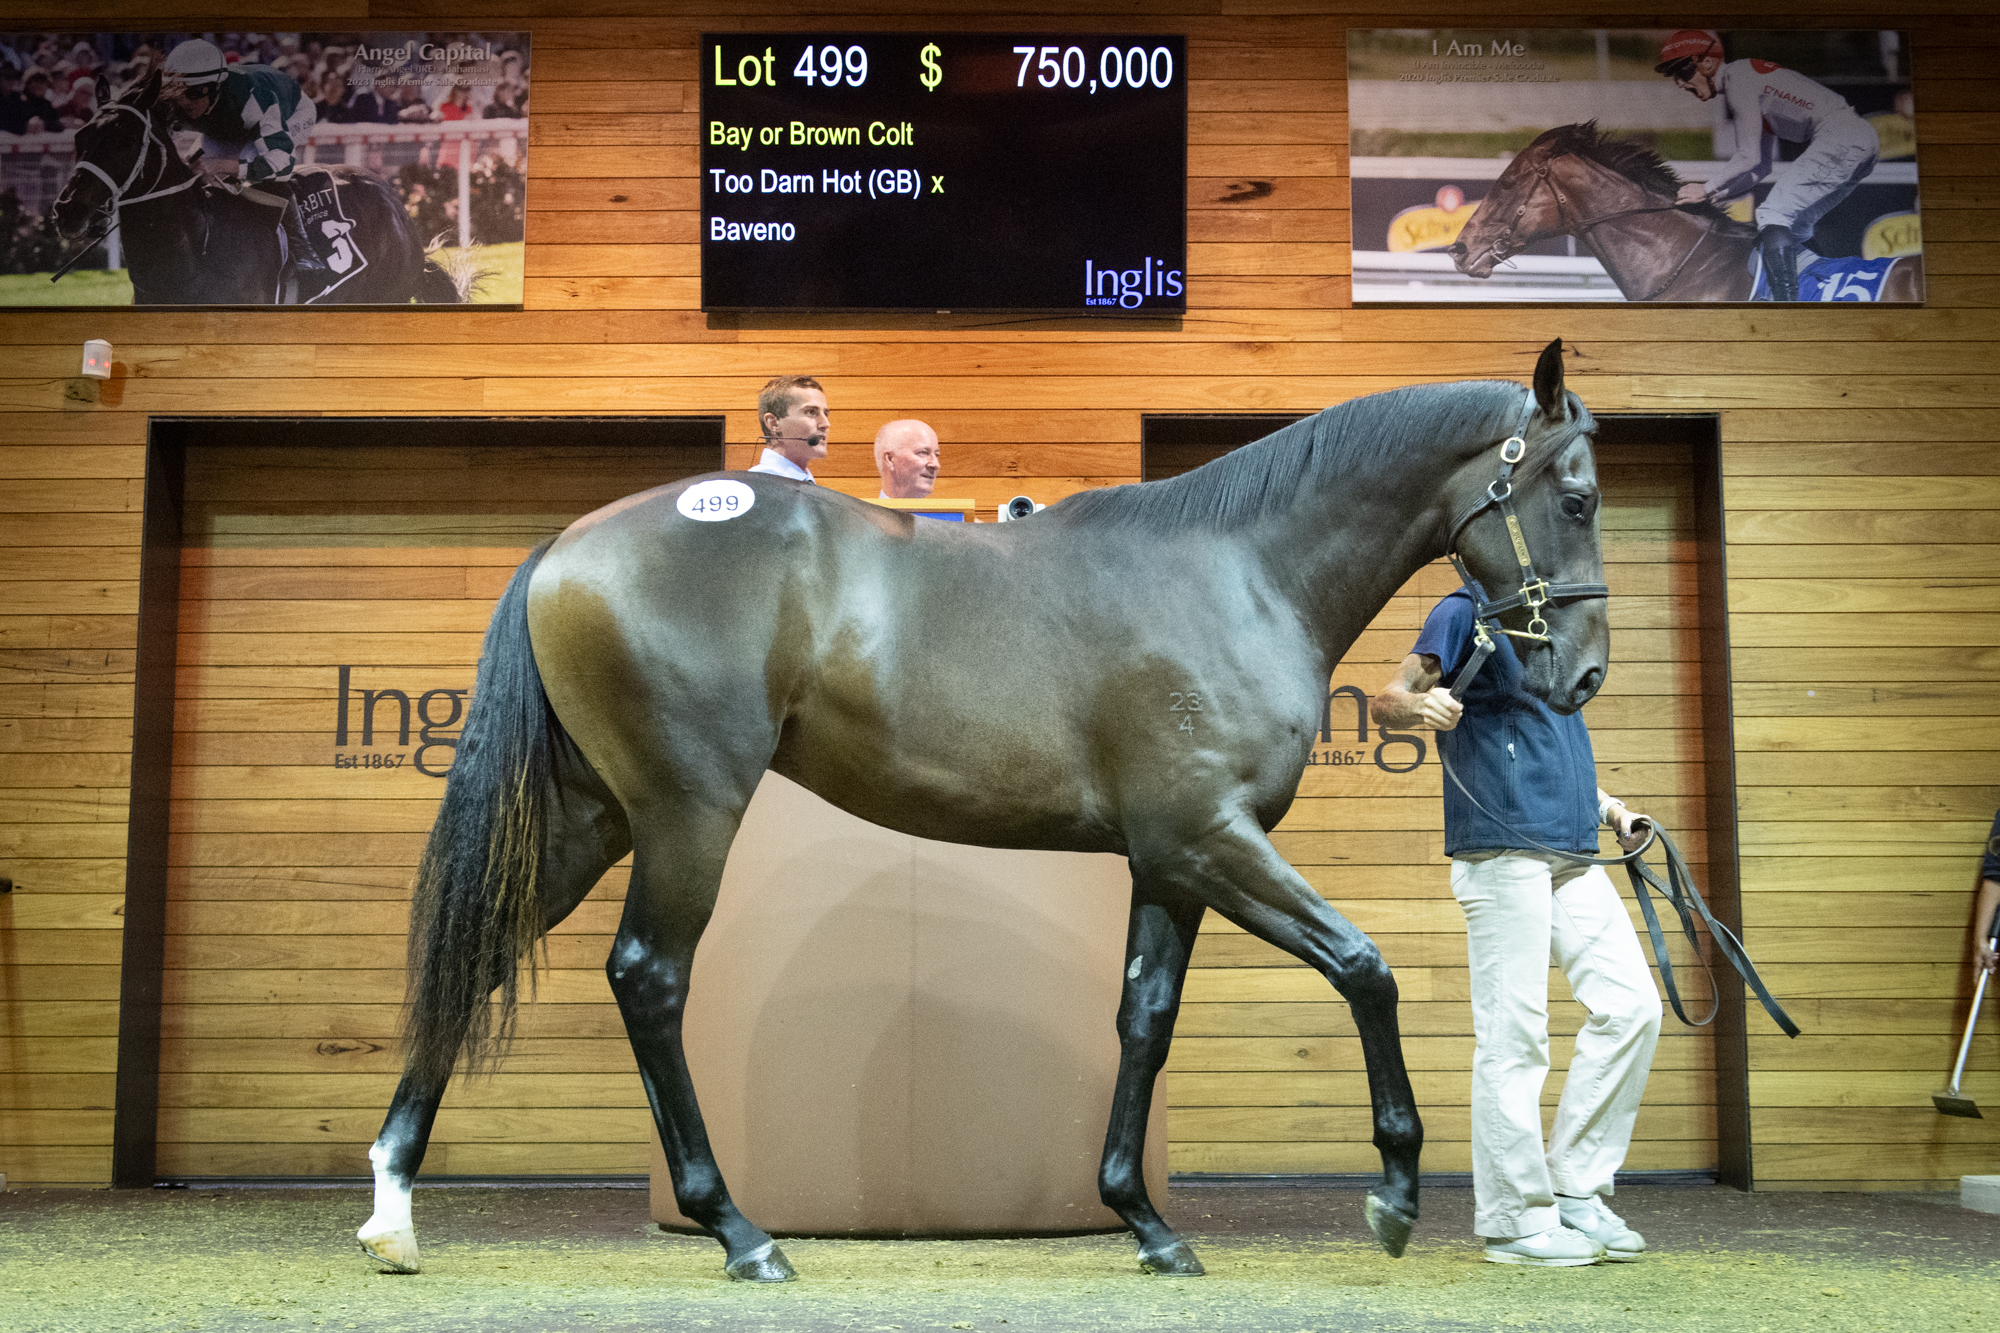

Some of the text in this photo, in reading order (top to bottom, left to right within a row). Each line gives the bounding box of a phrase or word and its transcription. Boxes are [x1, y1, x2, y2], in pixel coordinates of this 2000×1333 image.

[354, 42, 491, 66] Angel Capital
[1432, 39, 1525, 57] I Am Me
[356, 64, 384, 75] (Harry
[387, 64, 413, 75] Angel
[416, 64, 436, 75] (IRE)
[715, 42, 1173, 95] Lot 499 $ 750,000
[1400, 73, 1560, 84] 2020 Inglis Premier Sale Graduate
[346, 77, 498, 88] 2023 Inglis Premier Sale Graduate
[710, 121, 914, 151] Bay or Brown Colt
[709, 169, 945, 199] Too Darn Hot (GB) x
[710, 216, 796, 241] Baveno
[321, 219, 353, 274] 3
[1085, 256, 1183, 309] Inglis
[1817, 270, 1878, 302] 15
[1085, 297, 1117, 306] Est 1867
[691, 495, 739, 513] 499
[335, 664, 468, 778] Ing
[1179, 714, 1194, 737] 4
[334, 753, 406, 769] Est 1867
[1306, 750, 1366, 766] st 1867
